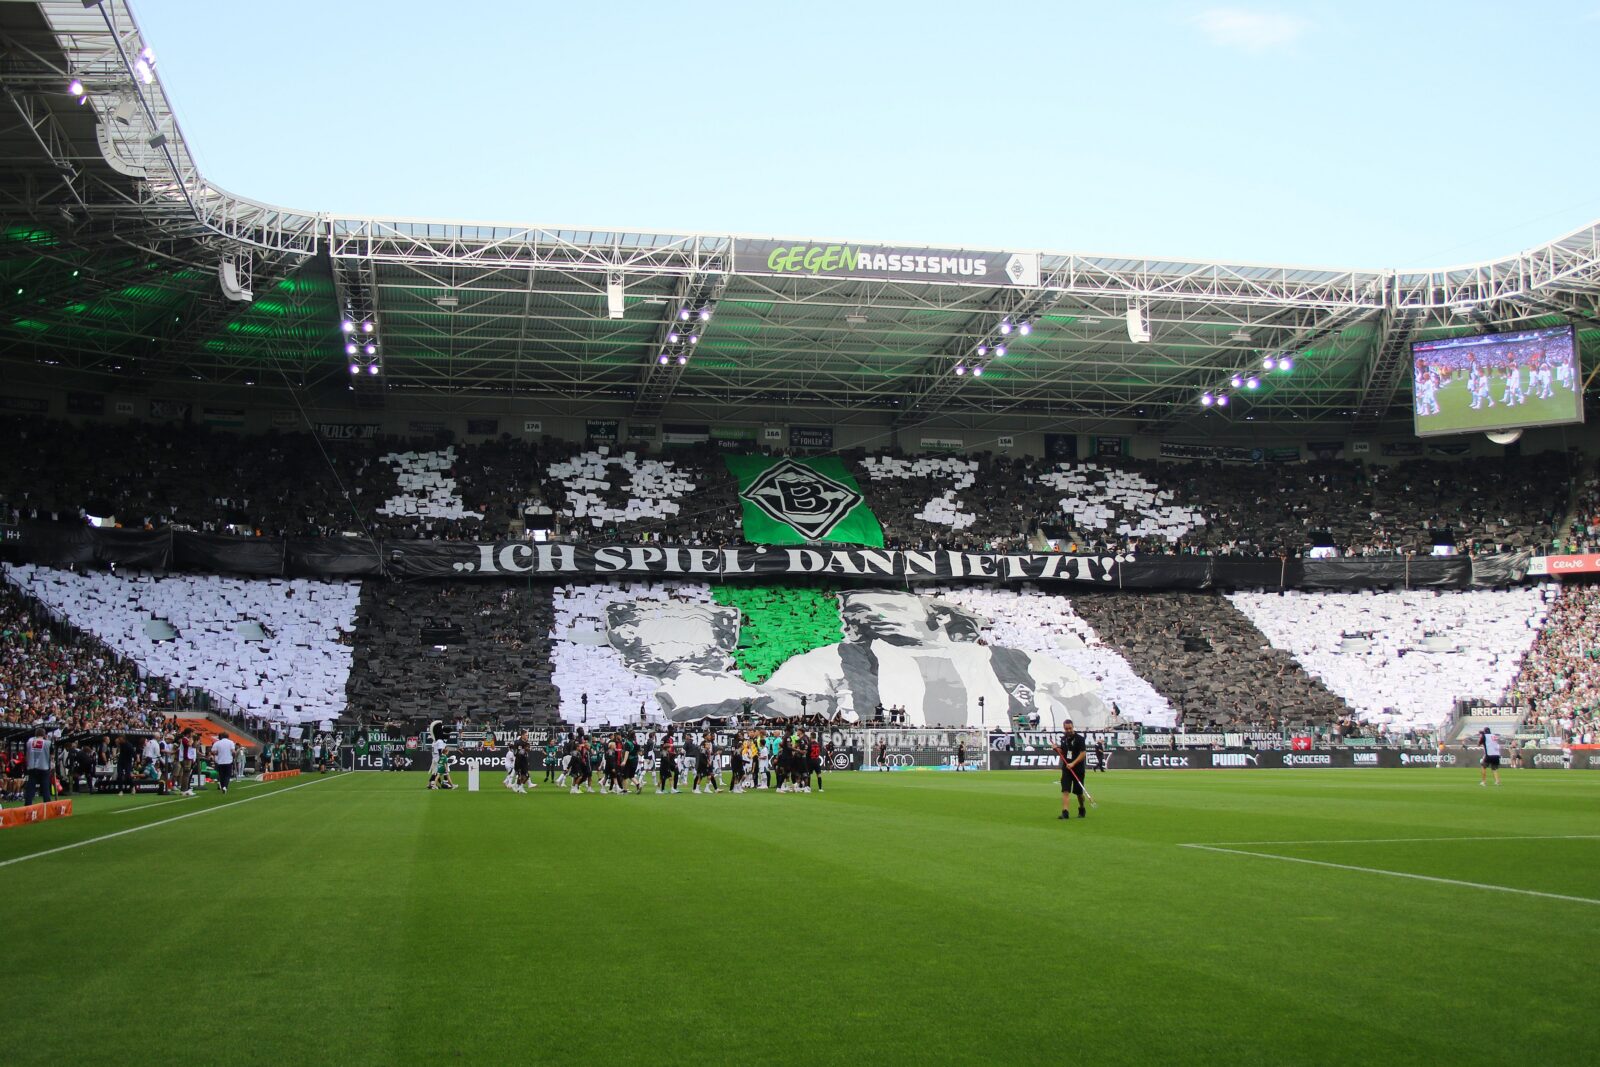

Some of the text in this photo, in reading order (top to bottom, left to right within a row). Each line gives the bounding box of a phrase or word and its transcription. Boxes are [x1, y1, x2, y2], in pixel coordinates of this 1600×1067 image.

[767, 245, 987, 276] GEGEN RASSISMUS
[785, 549, 937, 575] DANN
[1552, 559, 1585, 569] cewe
[1244, 732, 1283, 741] PUMUCKL
[459, 756, 507, 768] sonepa
[1010, 755, 1060, 766] ELTEN
[1138, 754, 1189, 767] flatex
[1212, 753, 1247, 766] PUMA
[1293, 755, 1331, 764] KYOCERA
[1410, 753, 1456, 763] reuter.de
